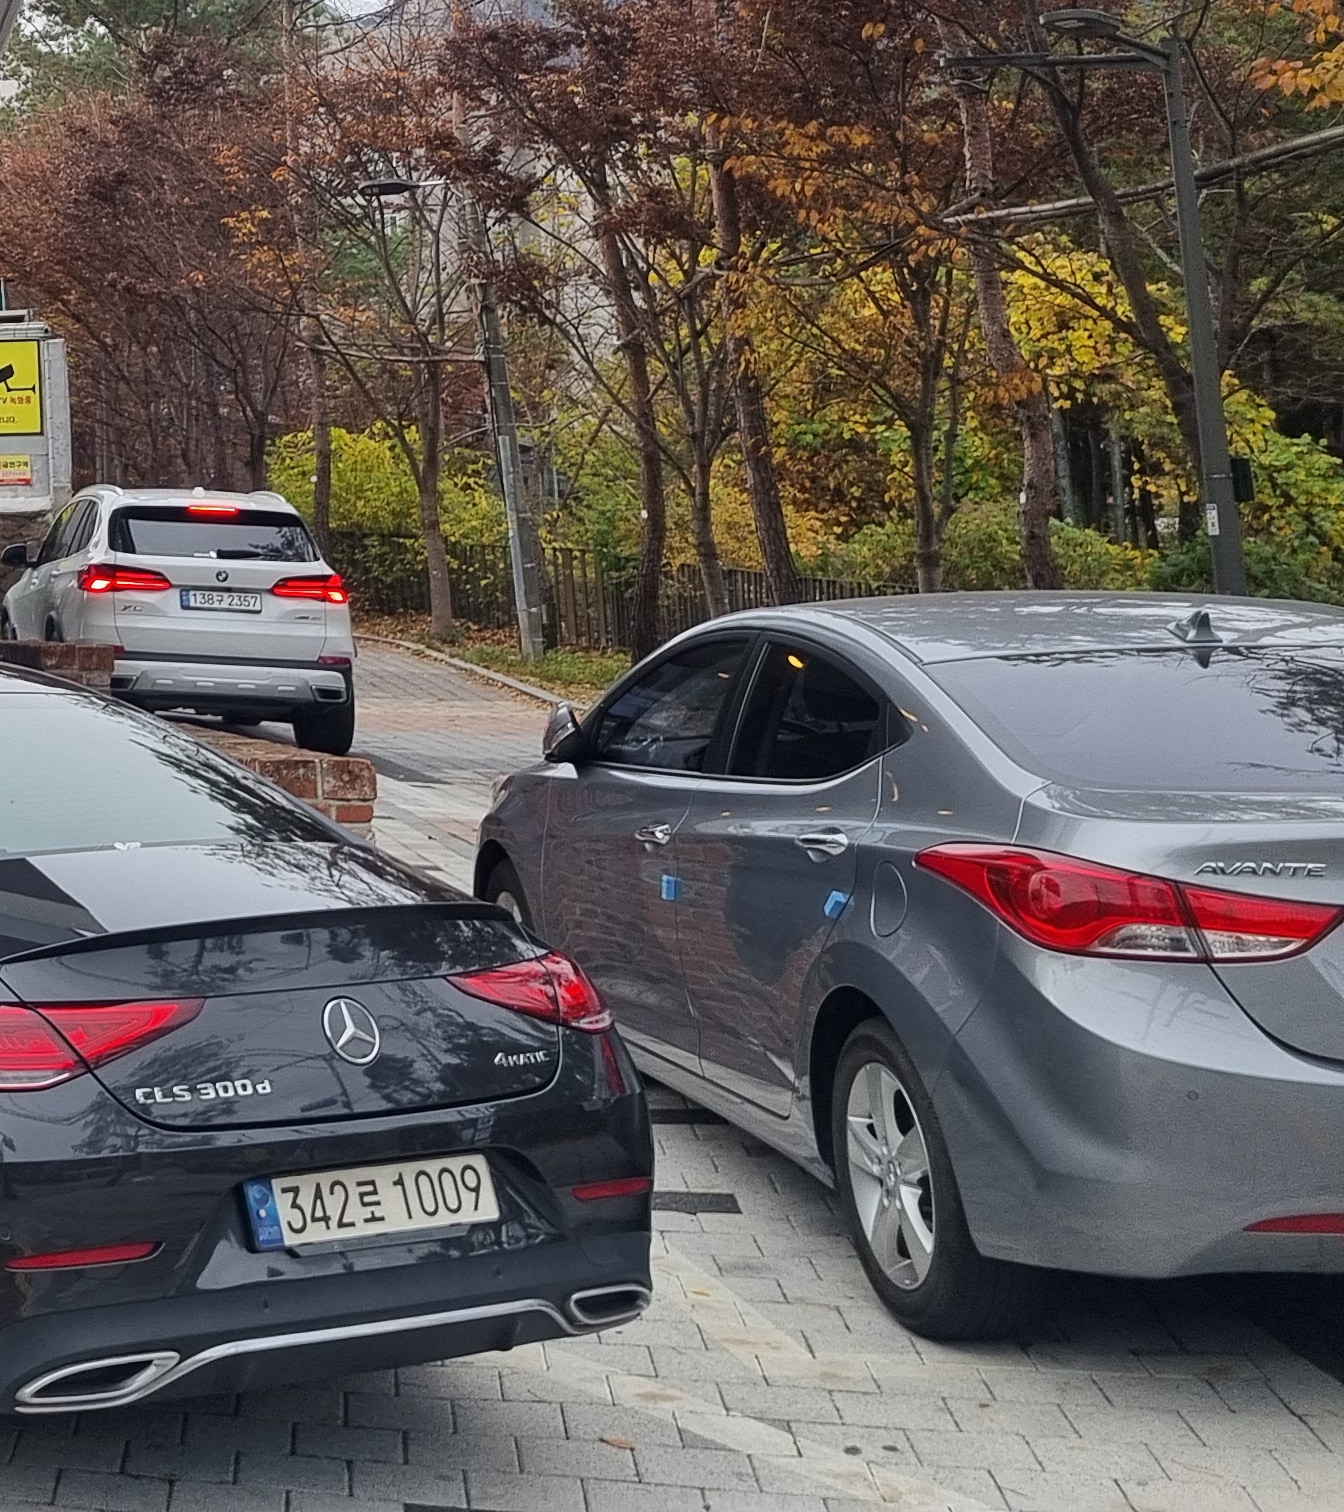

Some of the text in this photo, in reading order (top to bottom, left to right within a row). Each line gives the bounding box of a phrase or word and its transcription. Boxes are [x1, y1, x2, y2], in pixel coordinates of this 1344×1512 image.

[191, 592, 259, 608] 138구 2357
[1193, 861, 1327, 878] AVANTE
[494, 1049, 551, 1068] 4MATIC
[135, 1078, 272, 1106] CLS 300d
[280, 1163, 483, 1236] 342로 1009
